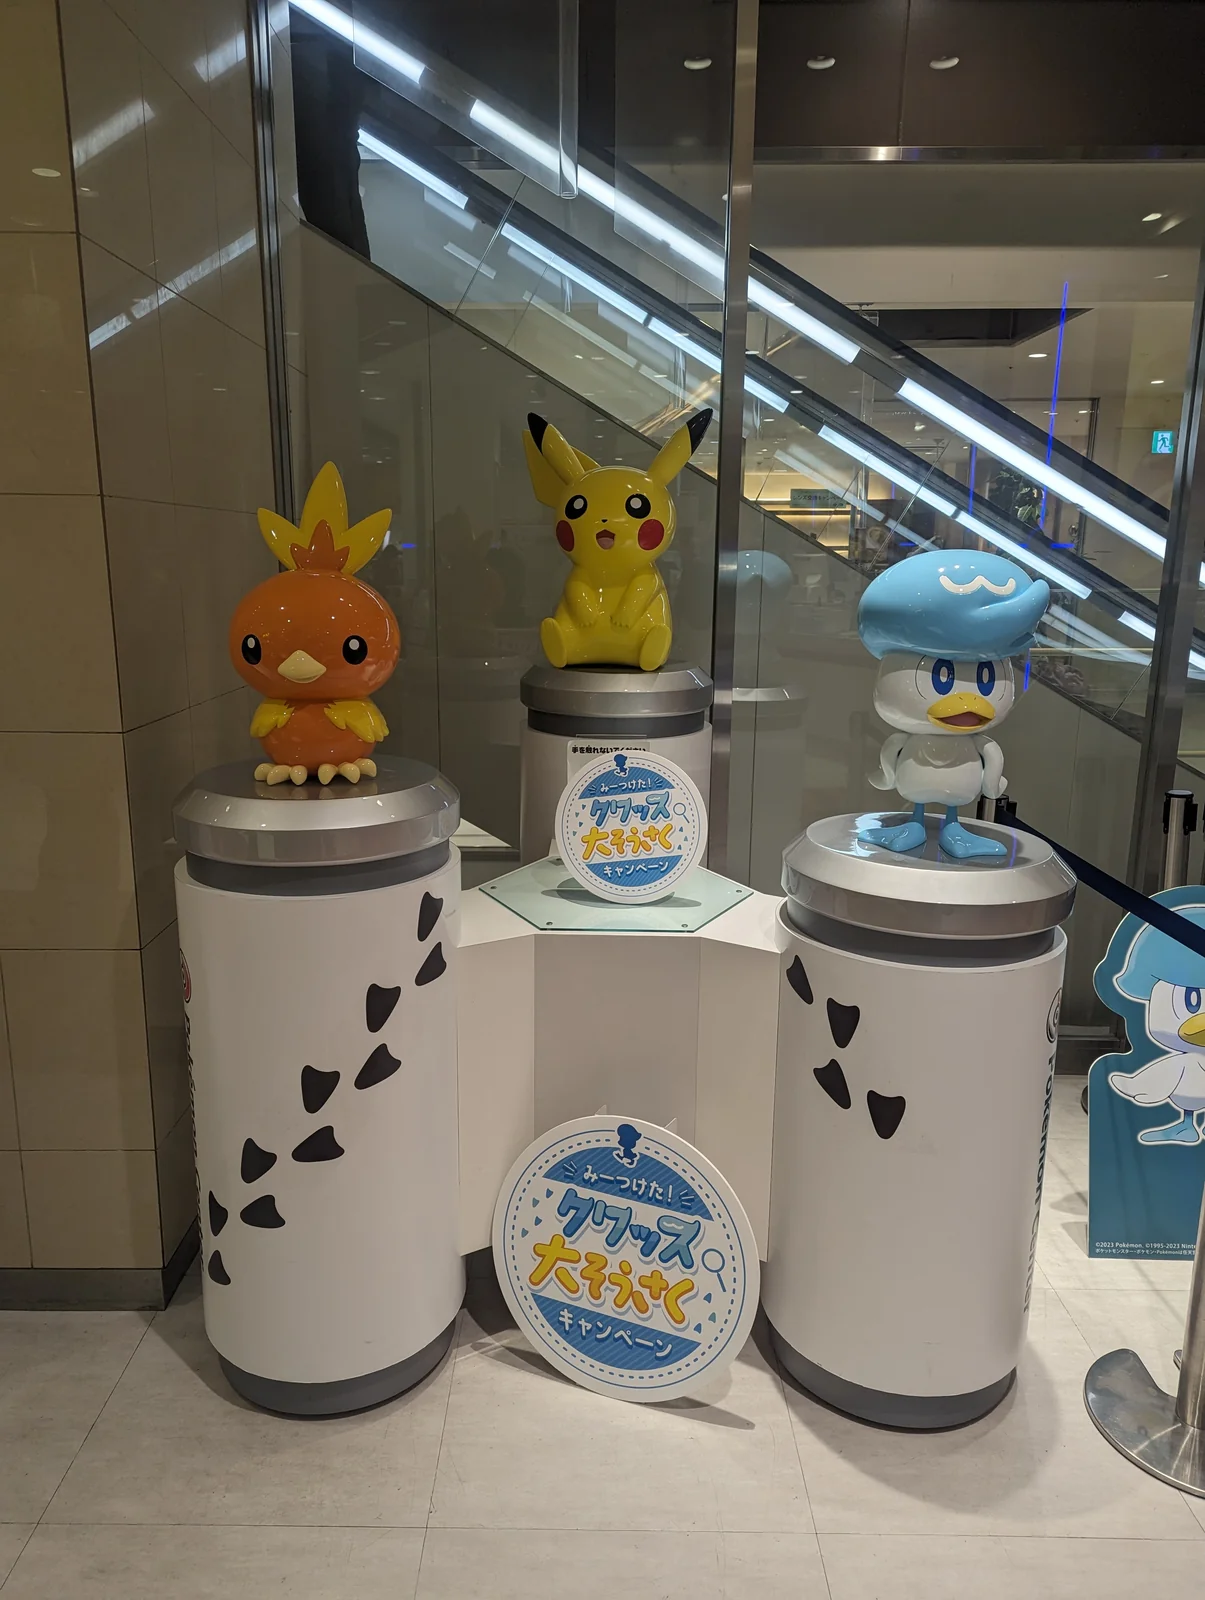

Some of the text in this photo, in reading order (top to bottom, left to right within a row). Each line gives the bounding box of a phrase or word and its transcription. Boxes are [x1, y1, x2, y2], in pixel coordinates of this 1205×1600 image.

[600, 778, 651, 792] みーつけた！
[590, 791, 671, 827] クワッス
[581, 823, 673, 861] 大そうさく
[603, 861, 669, 878] キャンペーン
[583, 1164, 673, 1202] みーつけた！
[557, 1188, 701, 1269] クワッス
[528, 1234, 695, 1325] 大そうさく
[558, 1308, 672, 1358] キャンペーン
